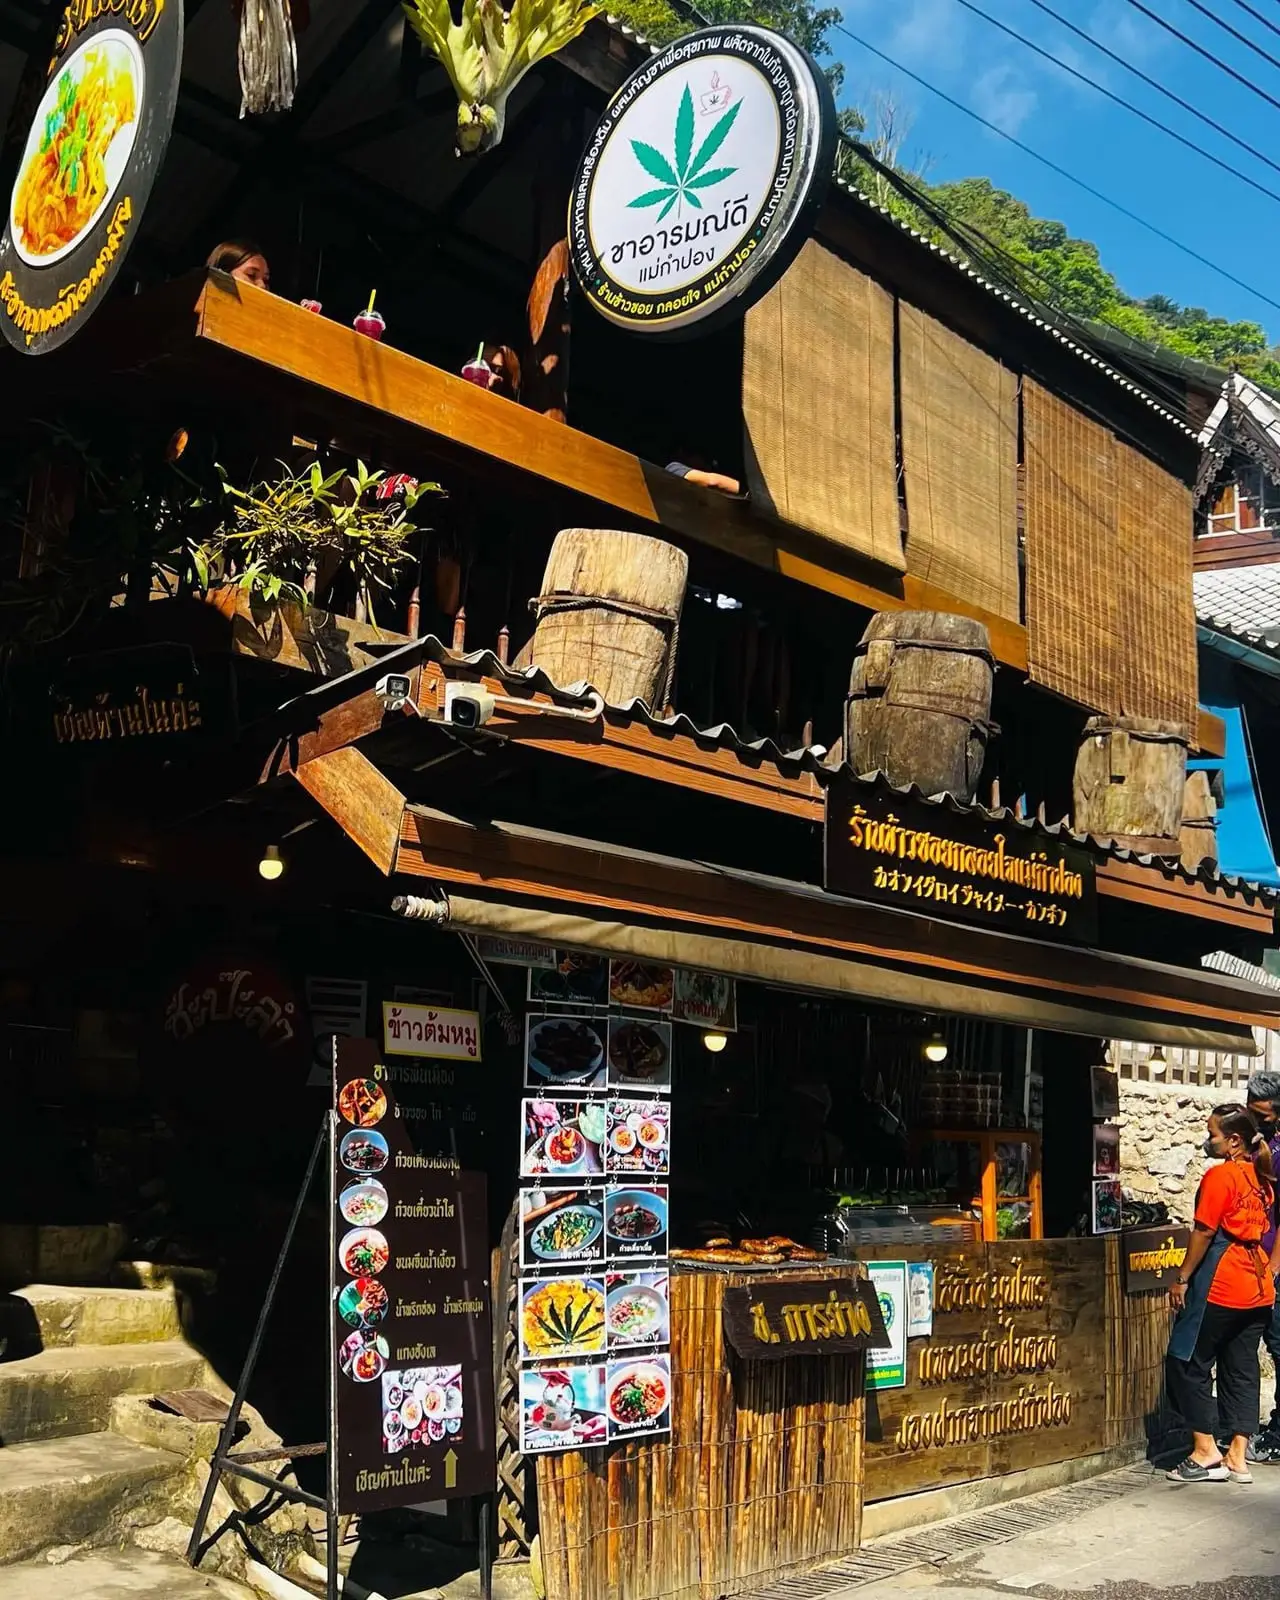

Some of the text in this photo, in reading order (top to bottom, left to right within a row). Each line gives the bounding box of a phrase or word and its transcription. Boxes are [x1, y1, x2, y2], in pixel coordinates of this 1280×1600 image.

[611, 194, 749, 264] ชาอารมณ์ดี
[597, 239, 757, 315] ร้านข้าวซอย กลอยใจ แม่กำปอง
[639, 247, 715, 283] แม่กำปอง
[388, 1007, 477, 1056] ข้าวต้มหมู
[396, 1343, 437, 1360] แกงฮังเล
[355, 1457, 432, 1492] เชิญด้านในค่ะ
